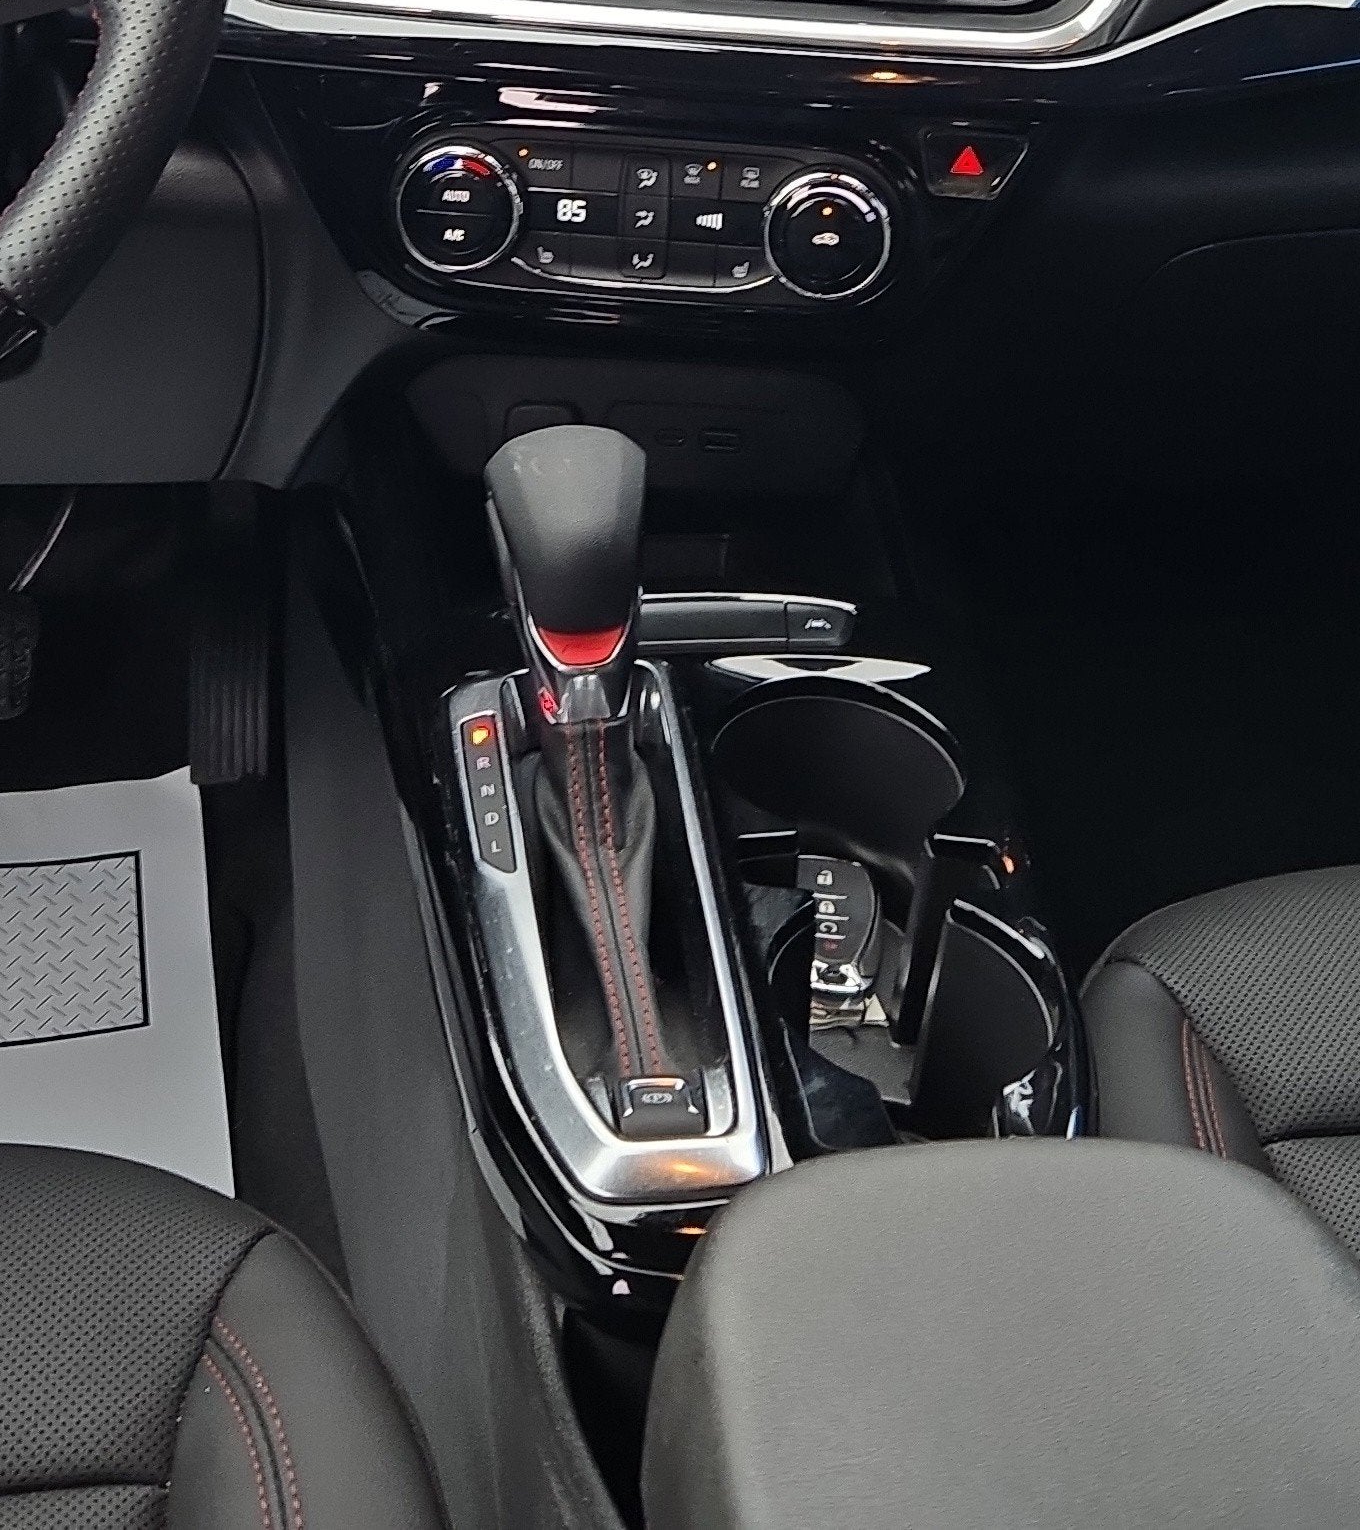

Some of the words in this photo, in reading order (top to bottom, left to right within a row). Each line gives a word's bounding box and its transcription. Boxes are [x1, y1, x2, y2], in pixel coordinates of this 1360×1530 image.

[528, 158, 564, 171] ON/OFF
[441, 189, 471, 203] AUTO
[442, 228, 466, 242] A/C
[475, 755, 491, 771] R
[480, 783, 496, 798] N
[484, 811, 500, 827] D
[490, 838, 502, 854] L
